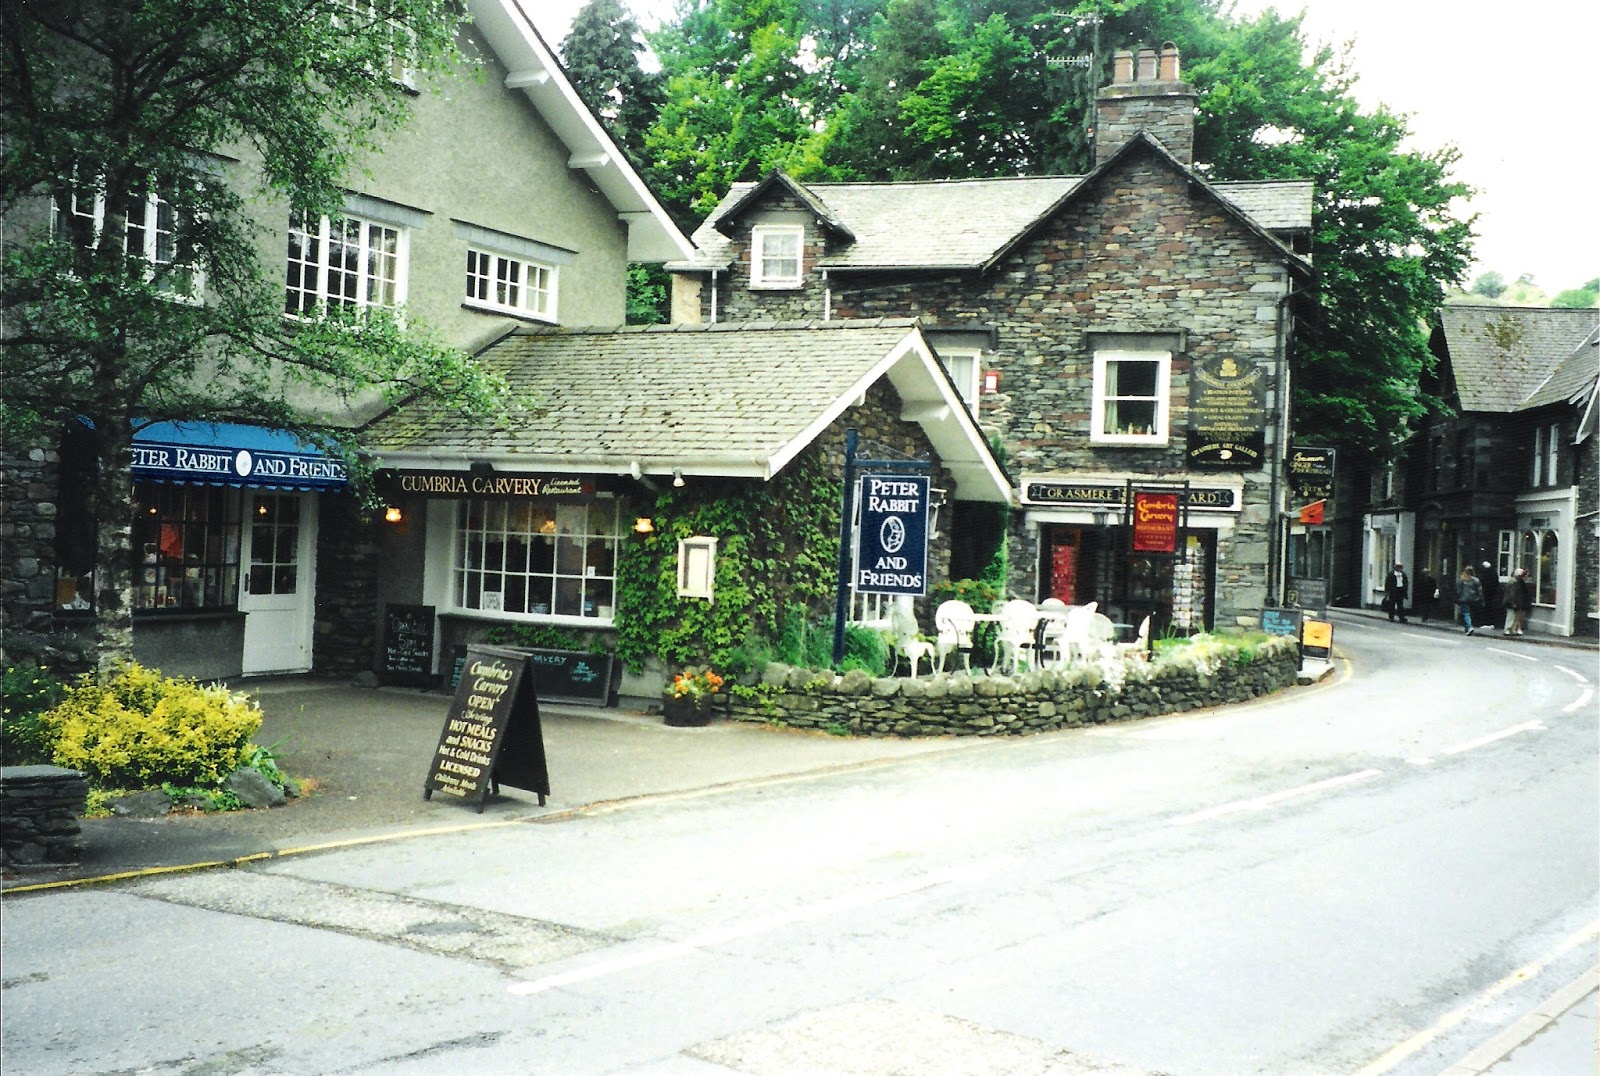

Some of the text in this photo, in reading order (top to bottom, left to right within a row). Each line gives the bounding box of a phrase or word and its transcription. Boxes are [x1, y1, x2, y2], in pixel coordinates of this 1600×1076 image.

[1191, 443, 1220, 457] GRASMERE
[1234, 444, 1259, 458] GALLERY
[175, 448, 232, 472] RABBIT
[253, 460, 286, 475] AND
[289, 458, 347, 478] FRIENDS
[401, 475, 541, 496] CUMBRIA CARVERY
[542, 484, 582, 495] Restaurant
[870, 480, 919, 496] PETER
[1046, 489, 1113, 500] GRASMERE
[869, 496, 920, 512] RABBIT
[1137, 500, 1176, 512] Cumbria
[1140, 510, 1173, 522] Carvery
[875, 557, 907, 570] AND
[860, 570, 922, 588] FRIENDS
[533, 655, 567, 664] ARVERY
[470, 661, 513, 681] Cumbria
[473, 677, 508, 702] Carvery
[468, 694, 495, 710] OPEN
[449, 719, 497, 740] HOT MEALS
[445, 735, 492, 753] and SNACKS
[438, 745, 491, 766] Hot & Cold Drinks
[440, 760, 481, 777] LICENSED
